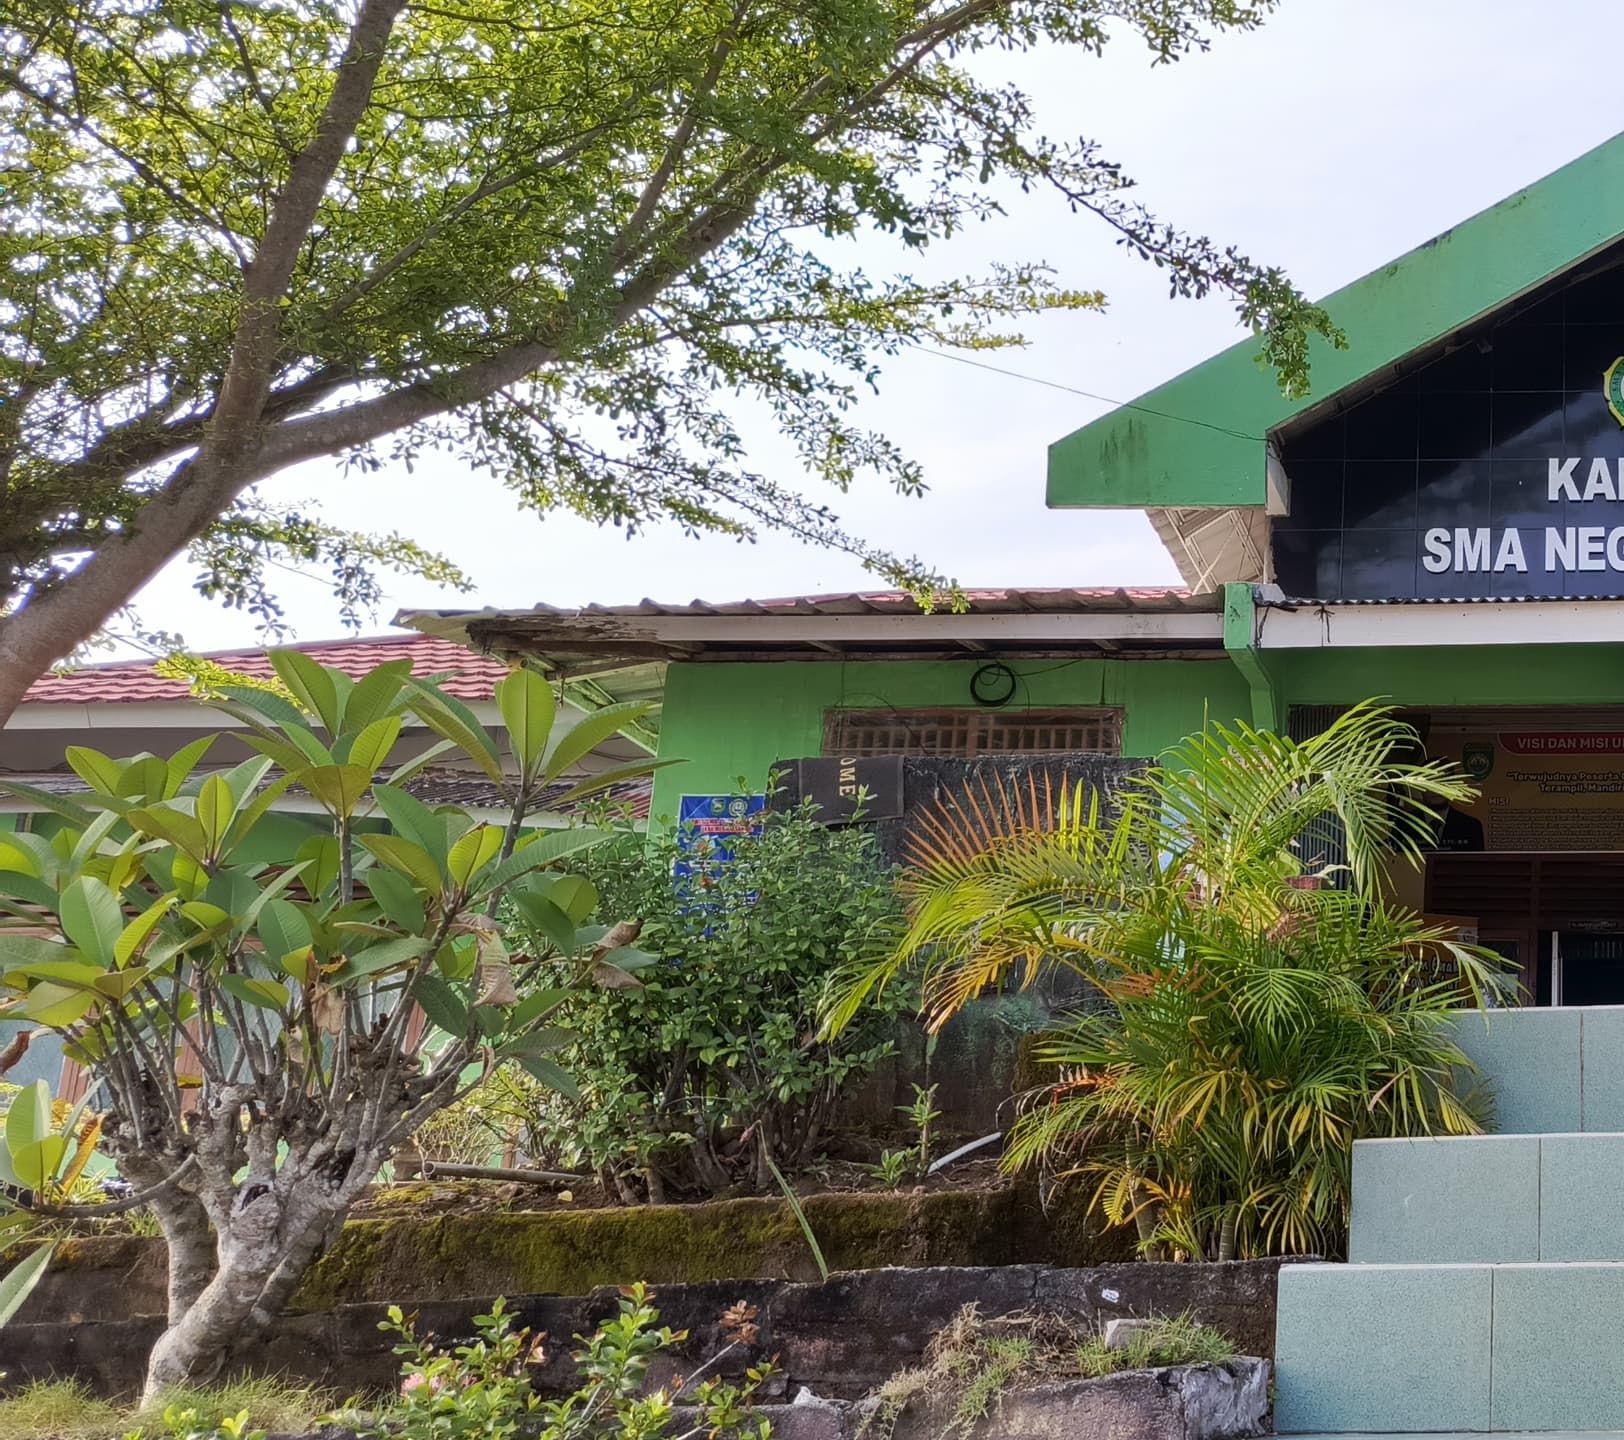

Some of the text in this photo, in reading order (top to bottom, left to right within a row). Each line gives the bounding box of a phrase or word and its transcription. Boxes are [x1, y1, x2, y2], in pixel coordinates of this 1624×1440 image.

[1422, 527, 1528, 573] SMA
[1517, 737, 1545, 749] VISI
[1548, 737, 1577, 749] DAN
[1580, 737, 1609, 749] MISI
[1580, 771, 1619, 782] Peserta
[1488, 796, 1511, 807] MISI
